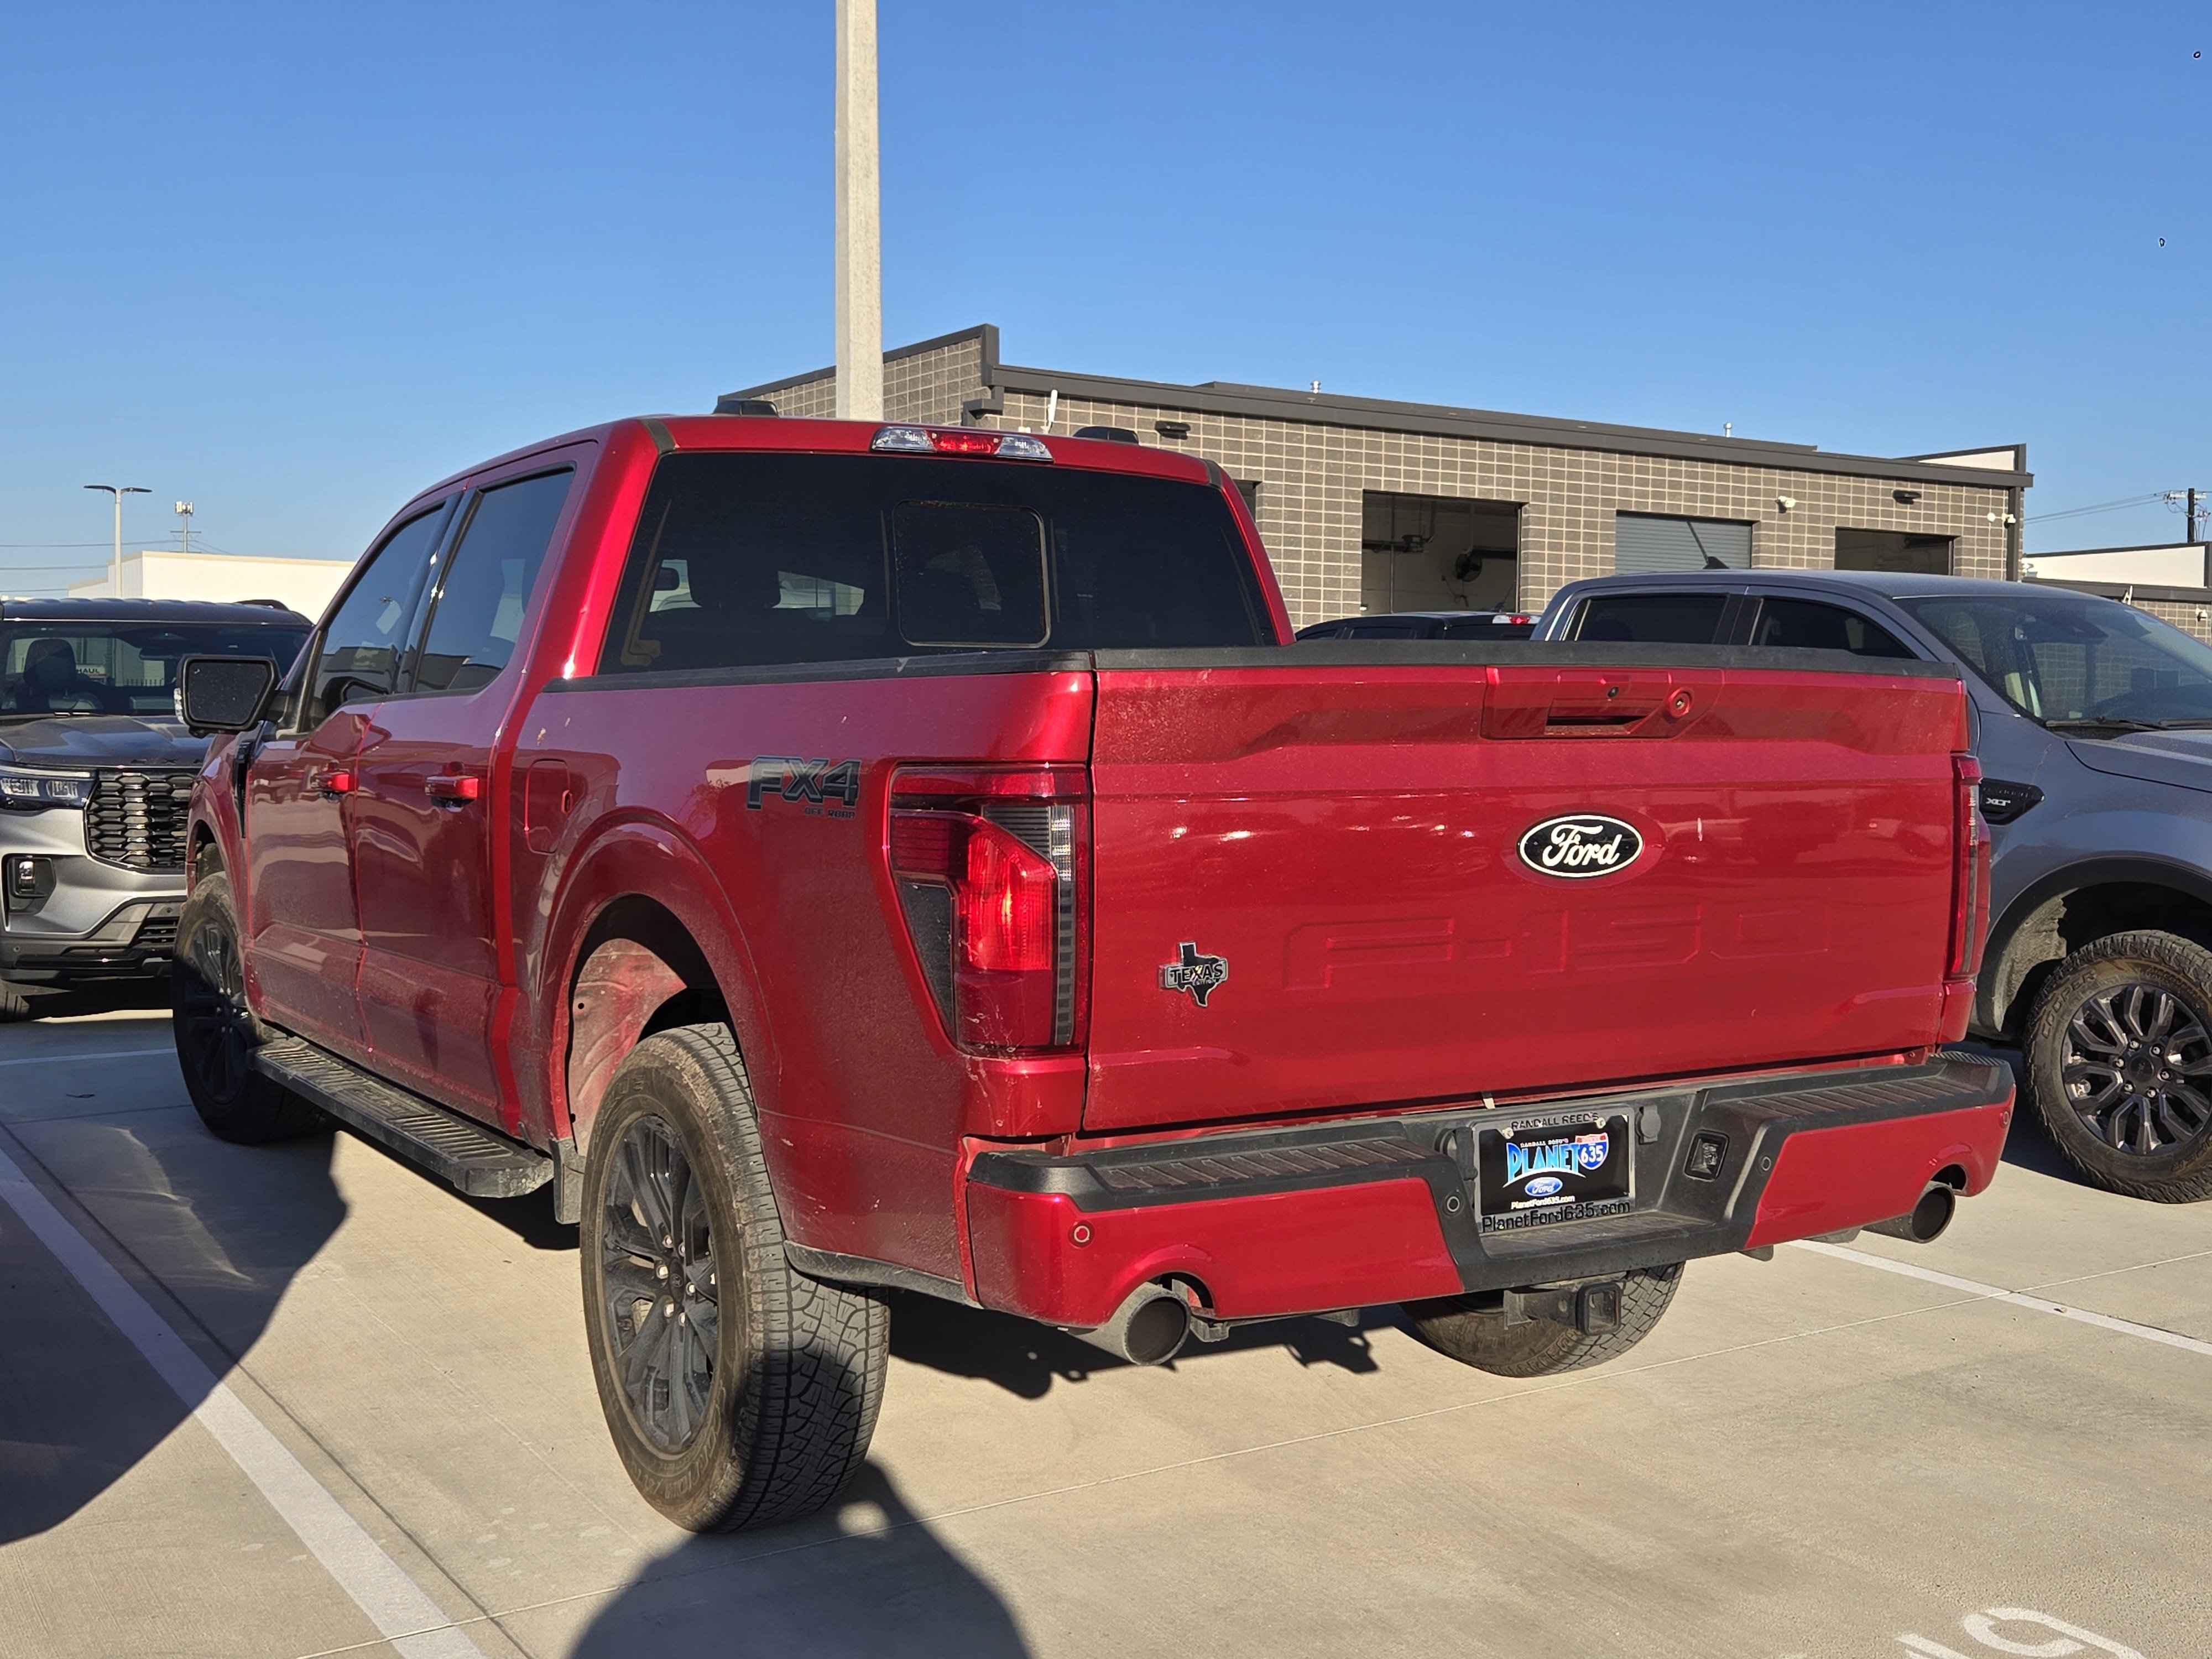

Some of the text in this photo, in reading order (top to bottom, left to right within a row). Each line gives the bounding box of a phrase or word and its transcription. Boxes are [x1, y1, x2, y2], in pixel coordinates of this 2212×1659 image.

[747, 755, 861, 811] FX4
[1986, 797, 2011, 806] XLT
[804, 807, 855, 820] OFF ROAD
[1542, 824, 1623, 867] Ford
[1283, 897, 1830, 990] F-150
[1170, 964, 1223, 983] TEXAS
[1511, 1118, 1559, 1130] RANDALL
[1506, 1141, 1581, 1183] PLANET
[1580, 1145, 1604, 1164] 635
[1532, 1182, 1554, 1194] Ford
[1482, 1201, 1631, 1233] PlanetFord635.com
